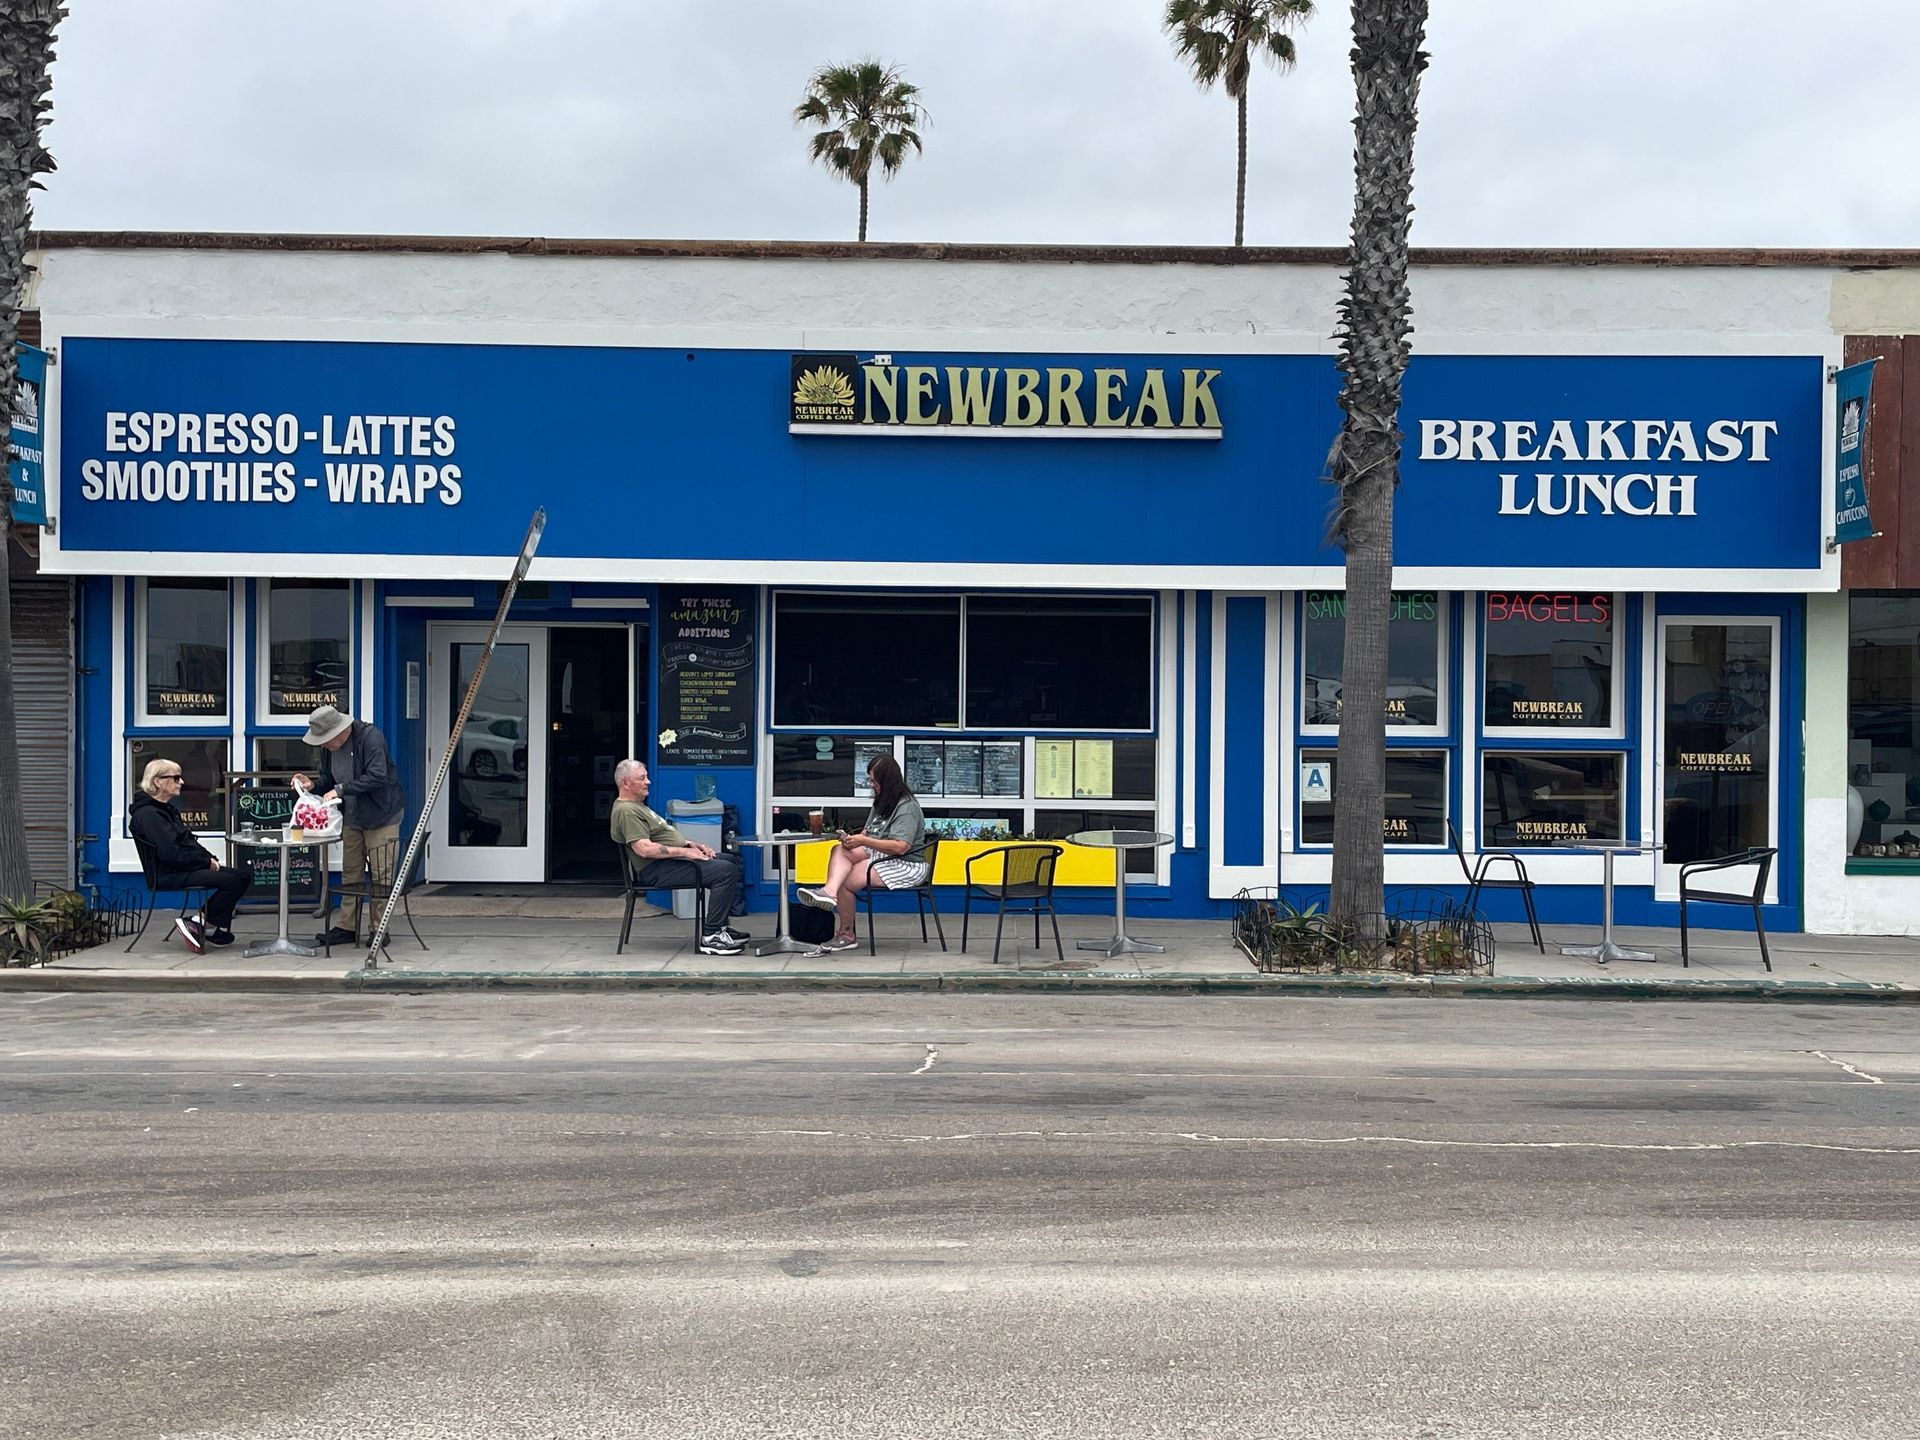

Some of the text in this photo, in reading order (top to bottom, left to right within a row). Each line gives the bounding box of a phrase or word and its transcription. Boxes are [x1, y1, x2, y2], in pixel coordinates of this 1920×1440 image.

[861, 365, 1222, 428] NEWBREAK
[795, 406, 854, 415] NEWBREAK
[1418, 420, 1778, 462] BREAKFAST
[21, 468, 29, 483] &
[15, 487, 37, 505] LUNCH
[1498, 474, 1698, 516] LUNCH
[681, 598, 732, 608] TRY THESE
[1488, 594, 1608, 623] BAGELS
[678, 627, 730, 638] ADDITIONS
[160, 693, 216, 703] NEWBREAK
[282, 693, 338, 703] NEWBREAK
[1512, 701, 1583, 713] NEWBREAK
[1680, 752, 1752, 765] NEWBREAK
[1307, 768, 1325, 787] A
[1516, 821, 1588, 834] NEWBREAK
